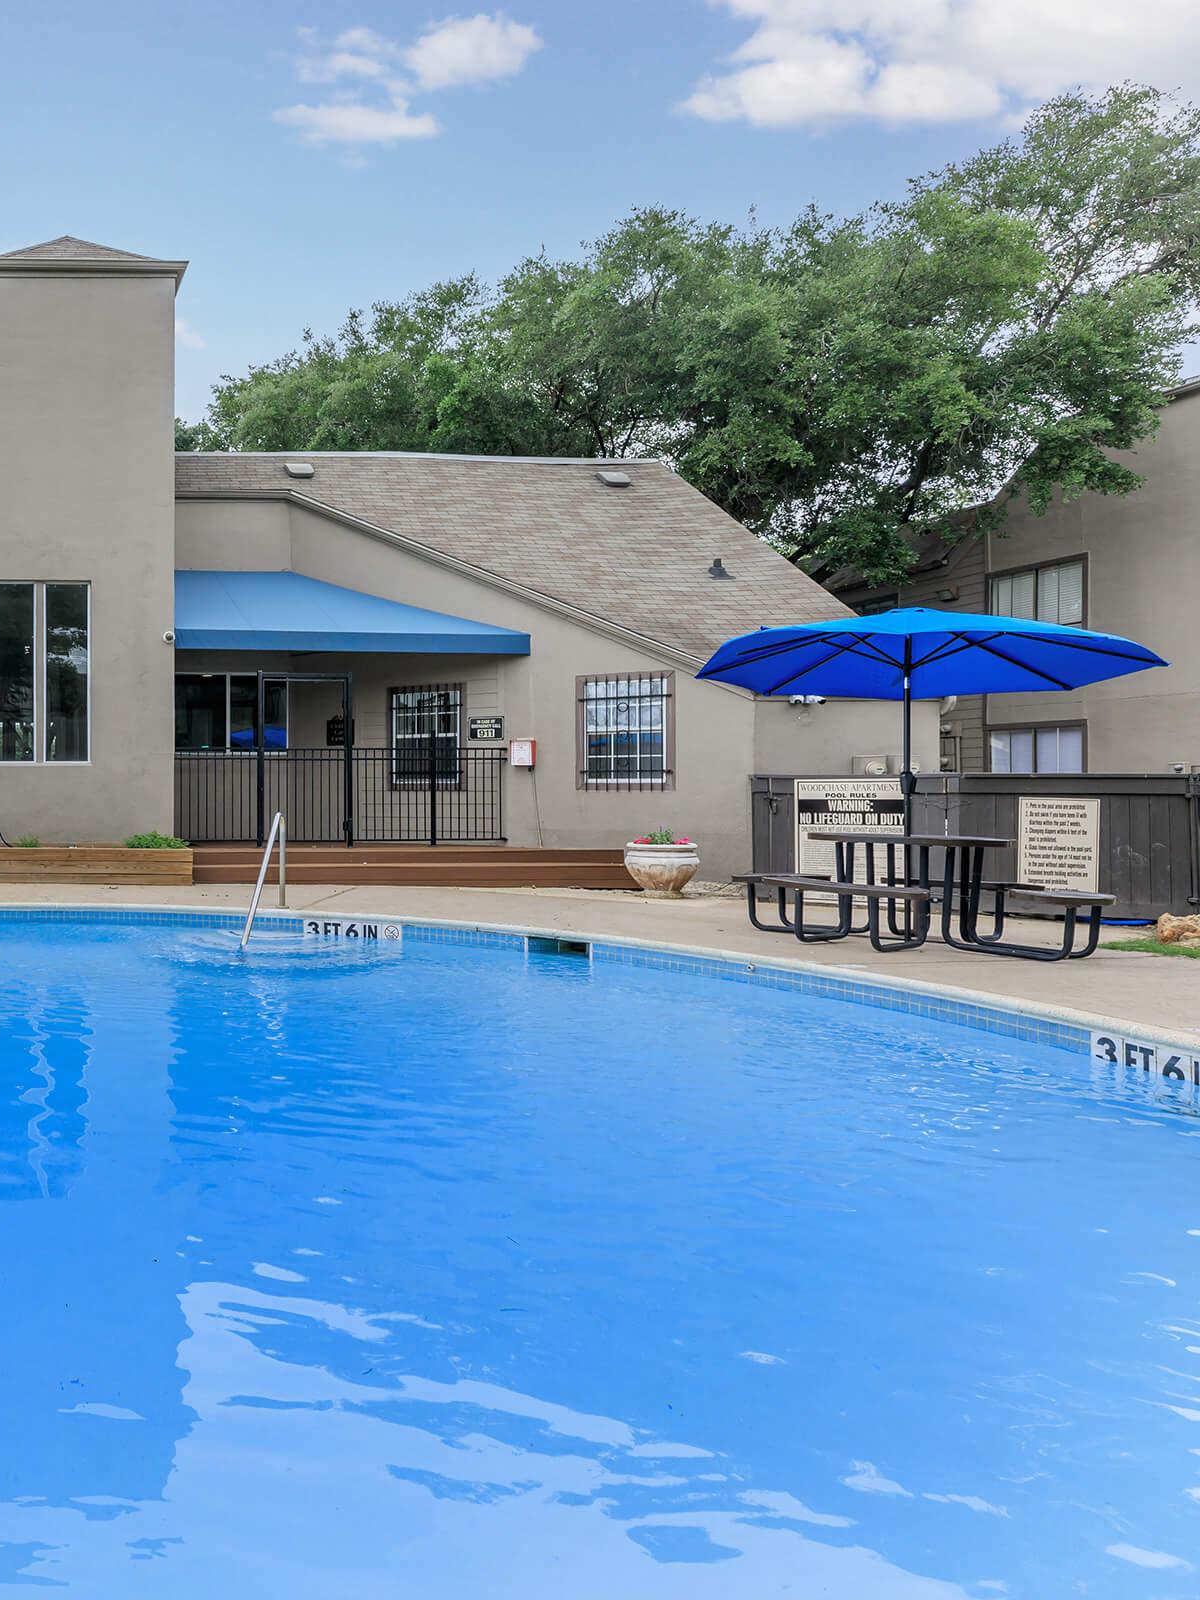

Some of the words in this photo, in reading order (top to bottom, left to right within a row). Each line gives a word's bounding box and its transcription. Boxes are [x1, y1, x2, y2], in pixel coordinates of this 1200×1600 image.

[800, 783, 848, 792] WOODCHASE
[850, 783, 899, 792] APARTMENT
[827, 800, 874, 812] WARNING:
[800, 812, 812, 825] NO
[813, 812, 863, 825] LIFEGUARD
[865, 813, 878, 825] ON
[880, 813, 905, 825] DUTY
[307, 922, 320, 935] 3
[324, 922, 341, 936] FT
[345, 924, 359, 938] 6
[363, 924, 378, 939] IN
[1096, 1037, 1117, 1062] 3
[1125, 1043, 1154, 1072] FT
[1162, 1055, 1185, 1080] 6
[1194, 1060, 1200, 1086] I
